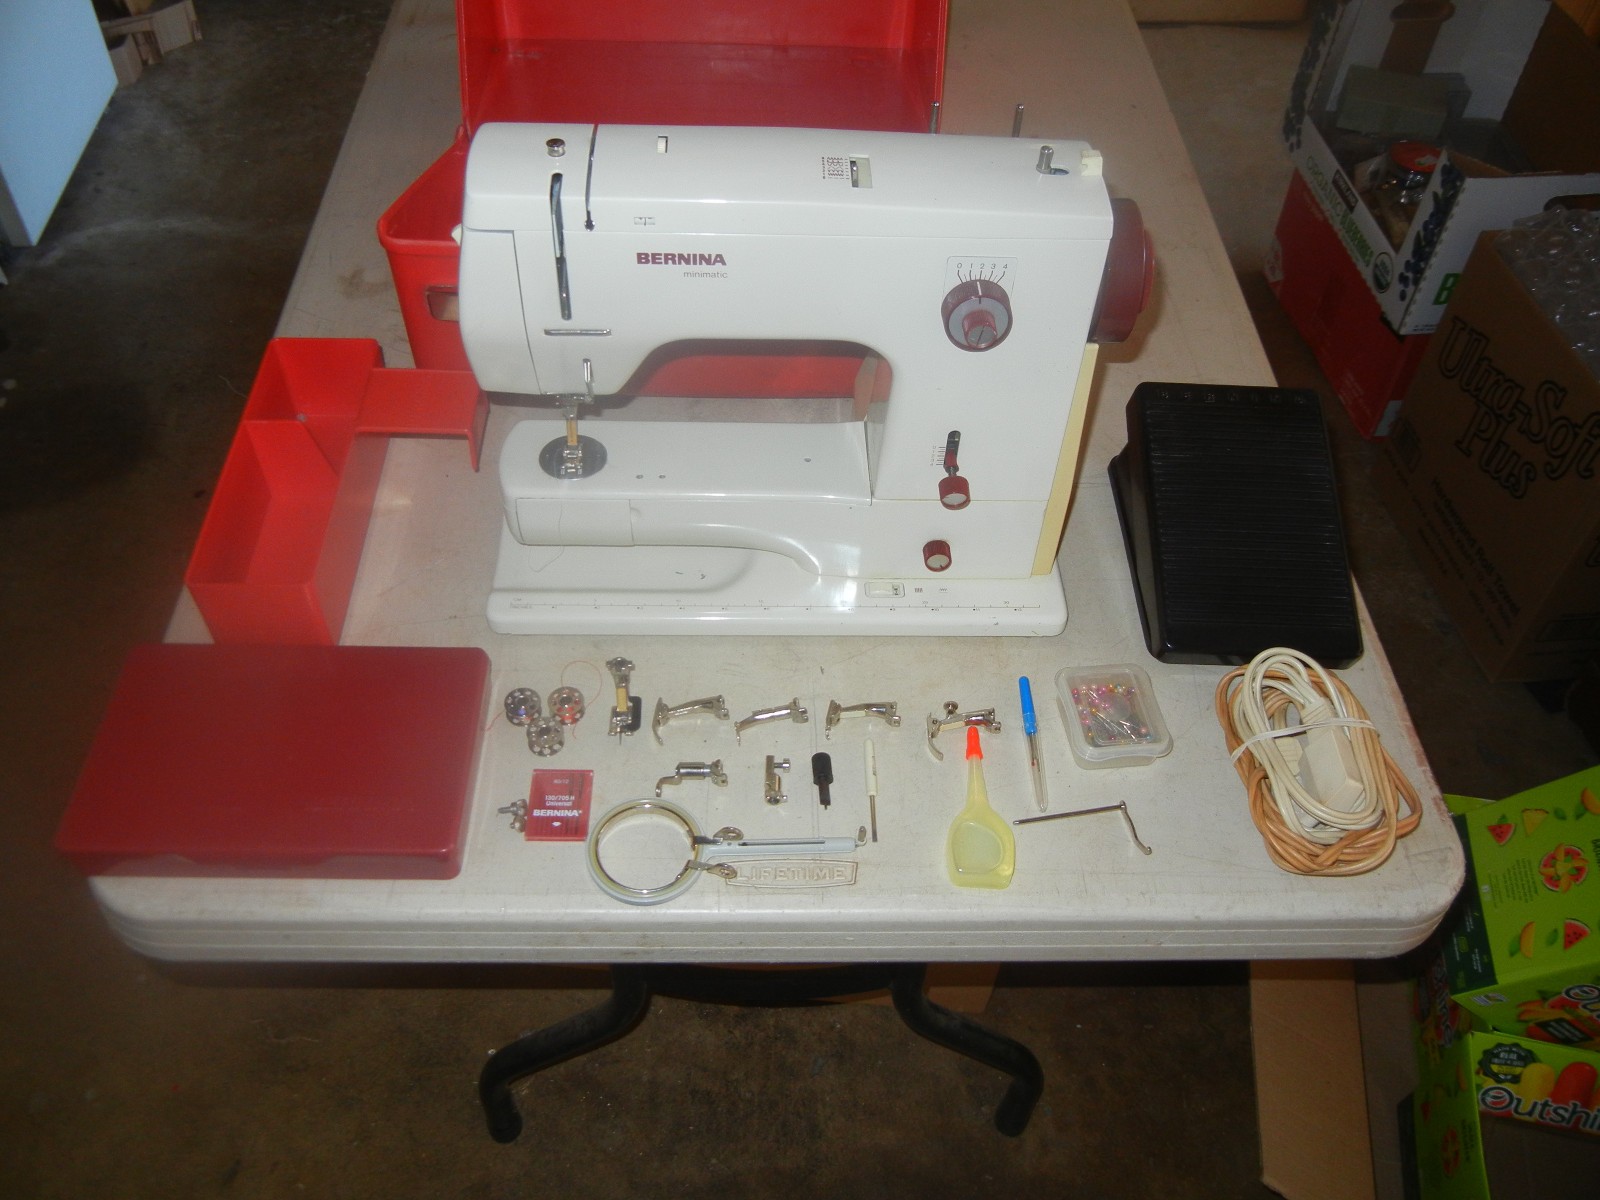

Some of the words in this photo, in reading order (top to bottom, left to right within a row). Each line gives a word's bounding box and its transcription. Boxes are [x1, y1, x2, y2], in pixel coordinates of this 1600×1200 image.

[636, 252, 727, 266] BERNINA
[683, 271, 729, 279] minimatic
[1454, 402, 1537, 500] Plus
[737, 864, 847, 880] LIFETIME
[1480, 1085, 1600, 1130] Outshi
